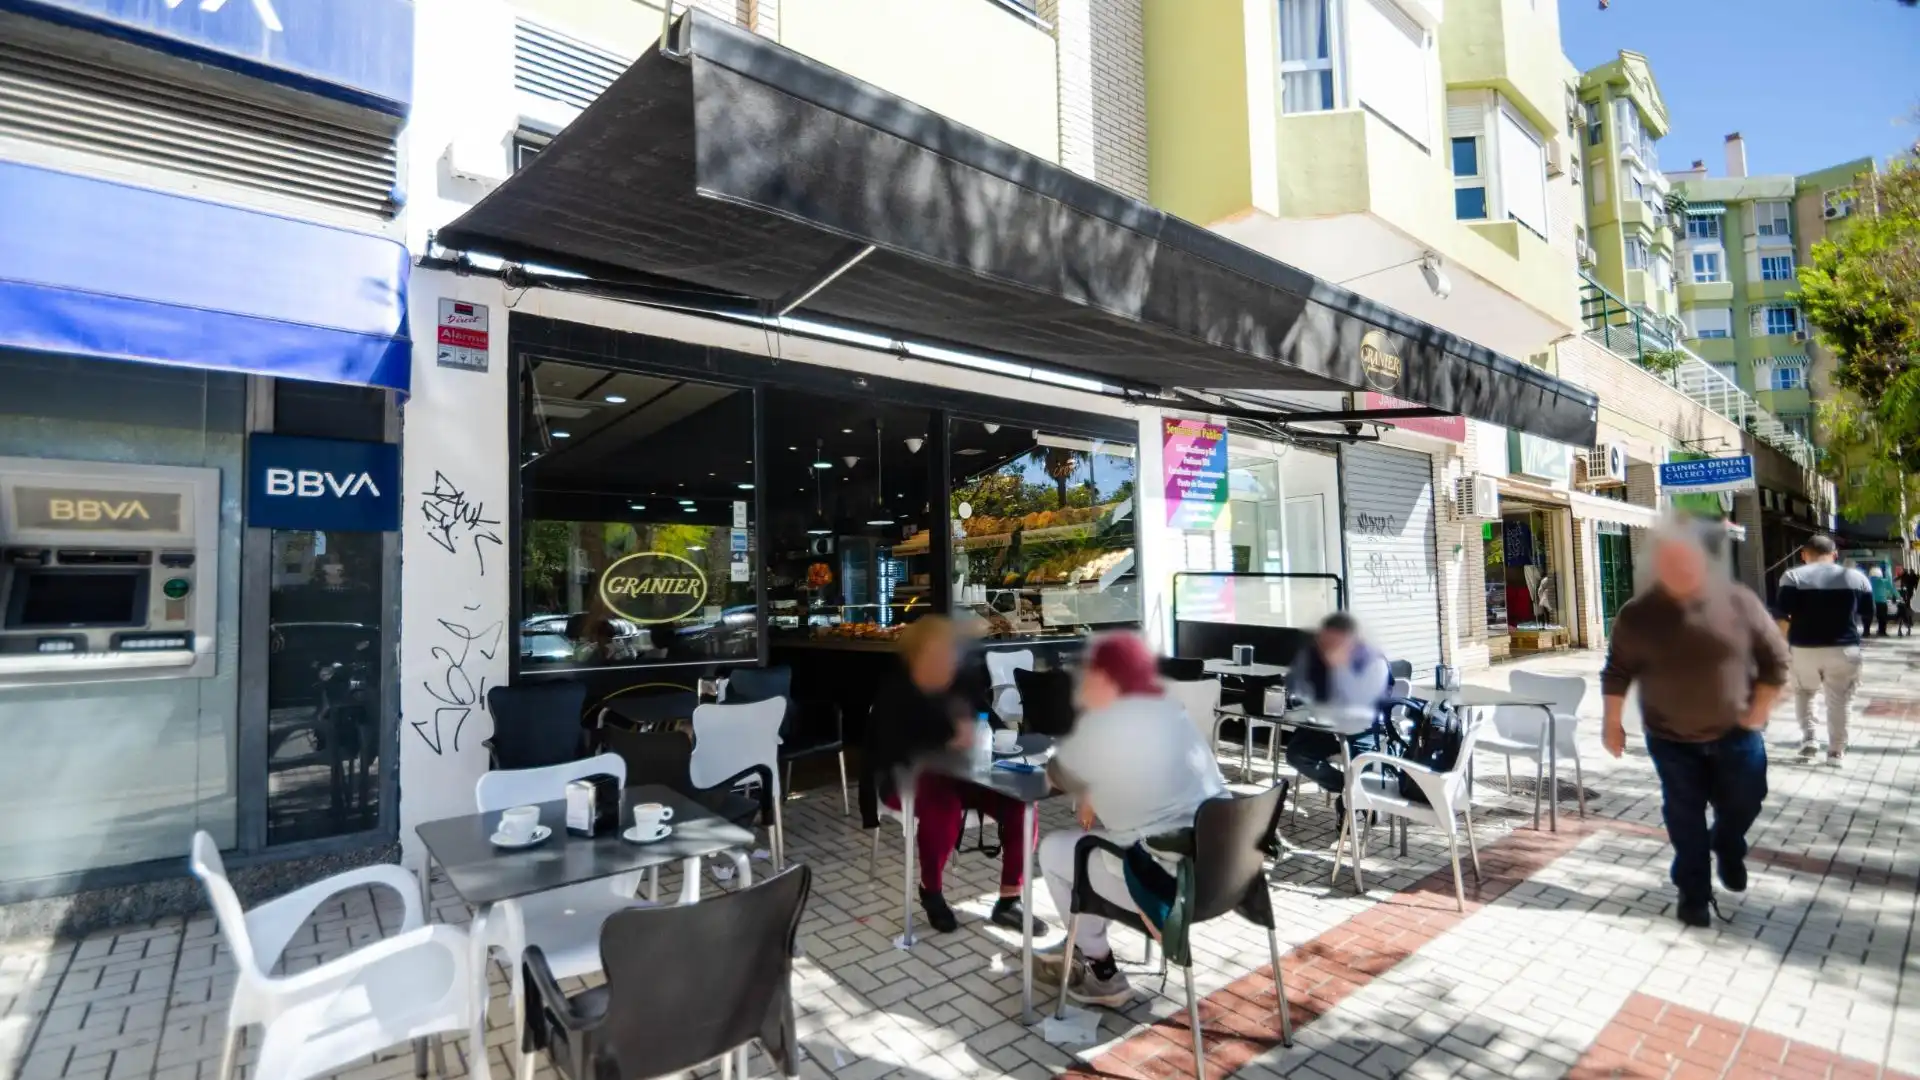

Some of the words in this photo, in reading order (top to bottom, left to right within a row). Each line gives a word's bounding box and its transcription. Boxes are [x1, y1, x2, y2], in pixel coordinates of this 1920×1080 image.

[441, 328, 487, 343] Alarma
[1361, 345, 1400, 374] GRANIER
[1665, 462, 1705, 473] CLINICA
[1708, 458, 1746, 469] DENTAL
[1665, 470, 1704, 480] CALERO
[1716, 466, 1747, 476] PERAL
[266, 468, 380, 498] BBVA
[49, 498, 150, 521] BBVA
[607, 576, 701, 599] GRANIER
